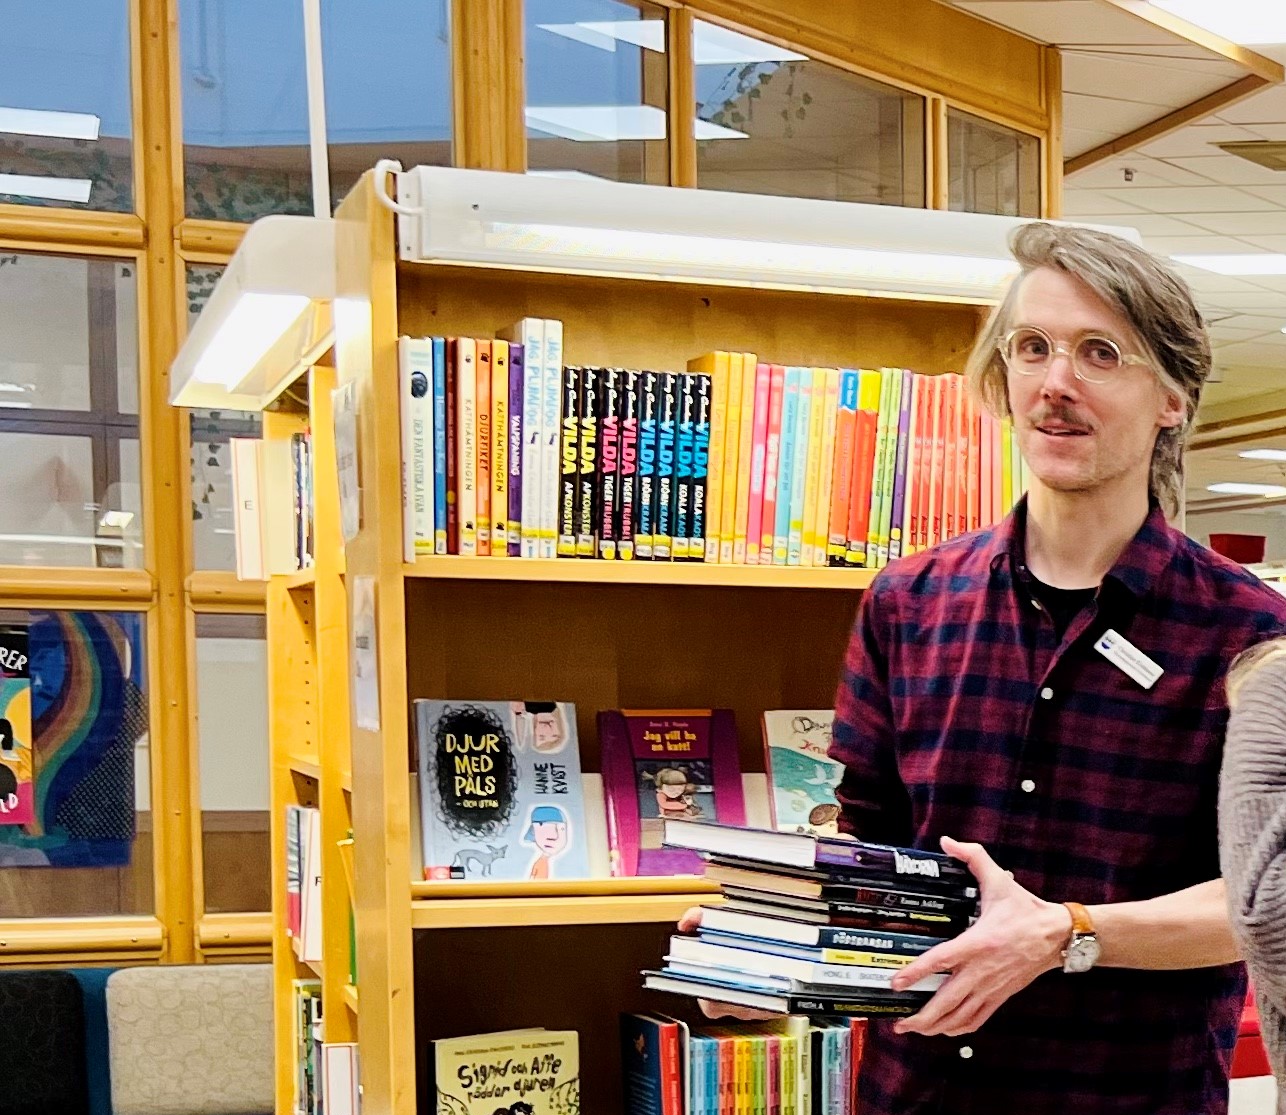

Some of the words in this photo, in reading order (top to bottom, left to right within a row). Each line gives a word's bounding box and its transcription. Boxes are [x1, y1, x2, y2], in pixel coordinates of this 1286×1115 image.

[563, 416, 578, 474] VILDA
[582, 416, 597, 474] VILDA
[602, 416, 618, 473] VILDA
[621, 417, 637, 475] VILDA
[640, 419, 655, 476] VILDA
[659, 420, 674, 476] VILDA
[678, 421, 693, 478] VILDA
[446, 733, 500, 753] DJUR
[454, 755, 494, 775] MED
